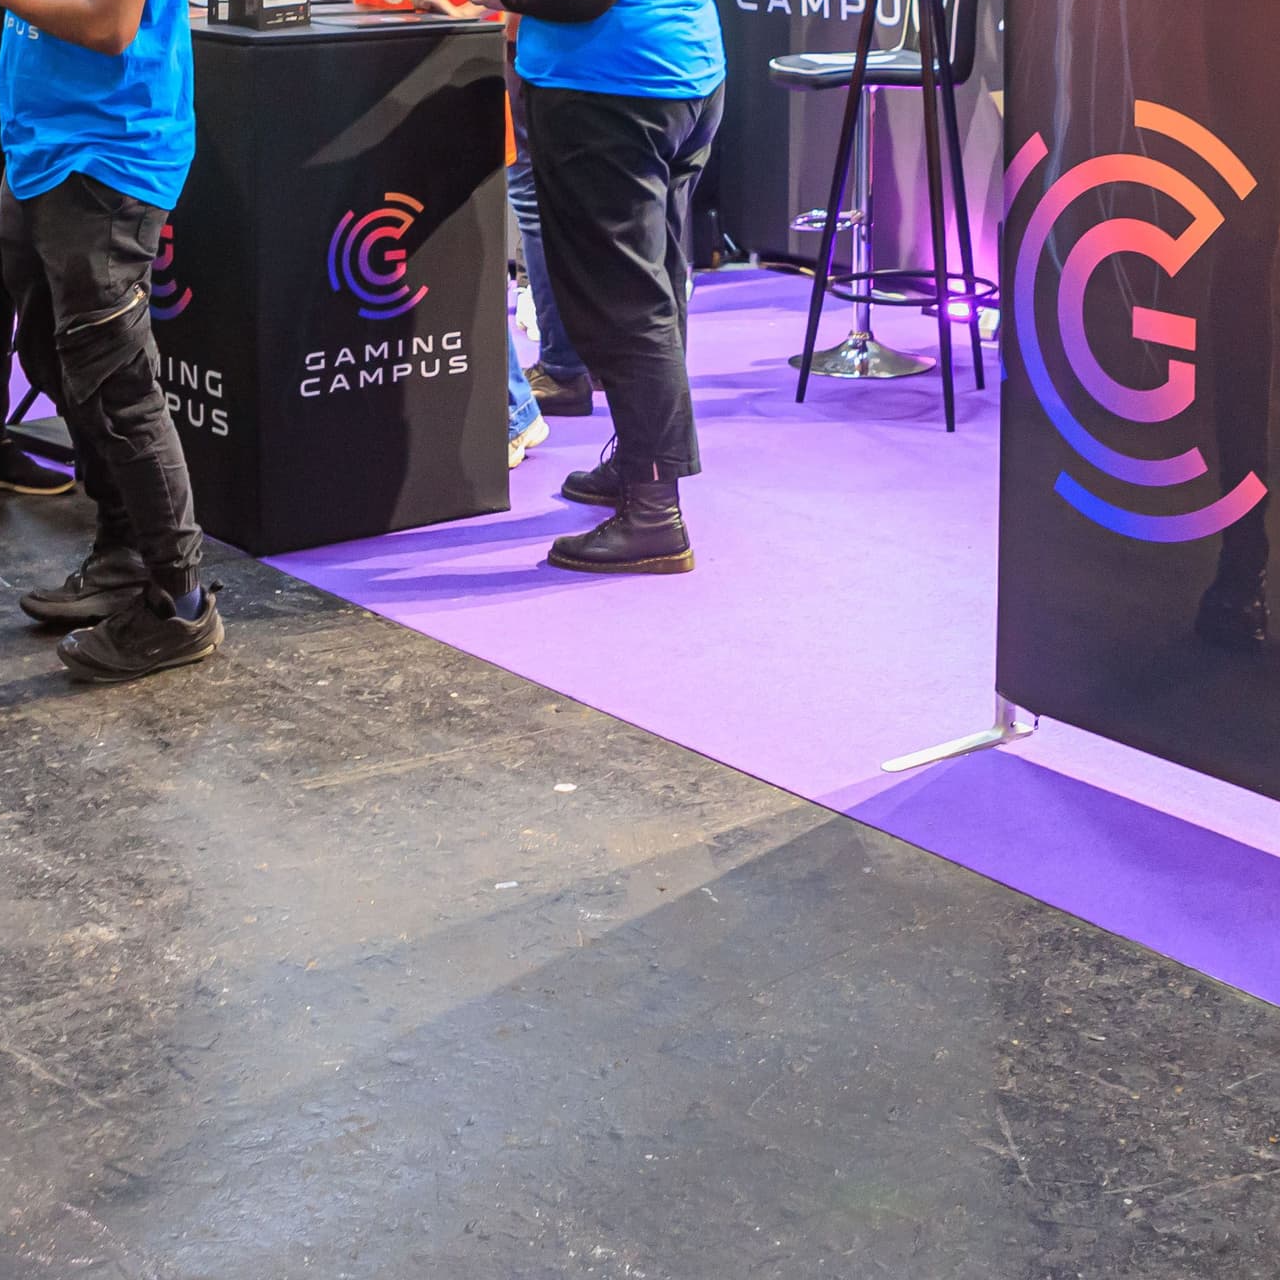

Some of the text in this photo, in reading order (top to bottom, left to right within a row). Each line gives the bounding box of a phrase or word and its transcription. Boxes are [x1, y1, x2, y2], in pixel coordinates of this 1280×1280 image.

[304, 331, 463, 371] GAMING
[300, 354, 469, 398] CAMPUS
[164, 392, 230, 437] PUS
